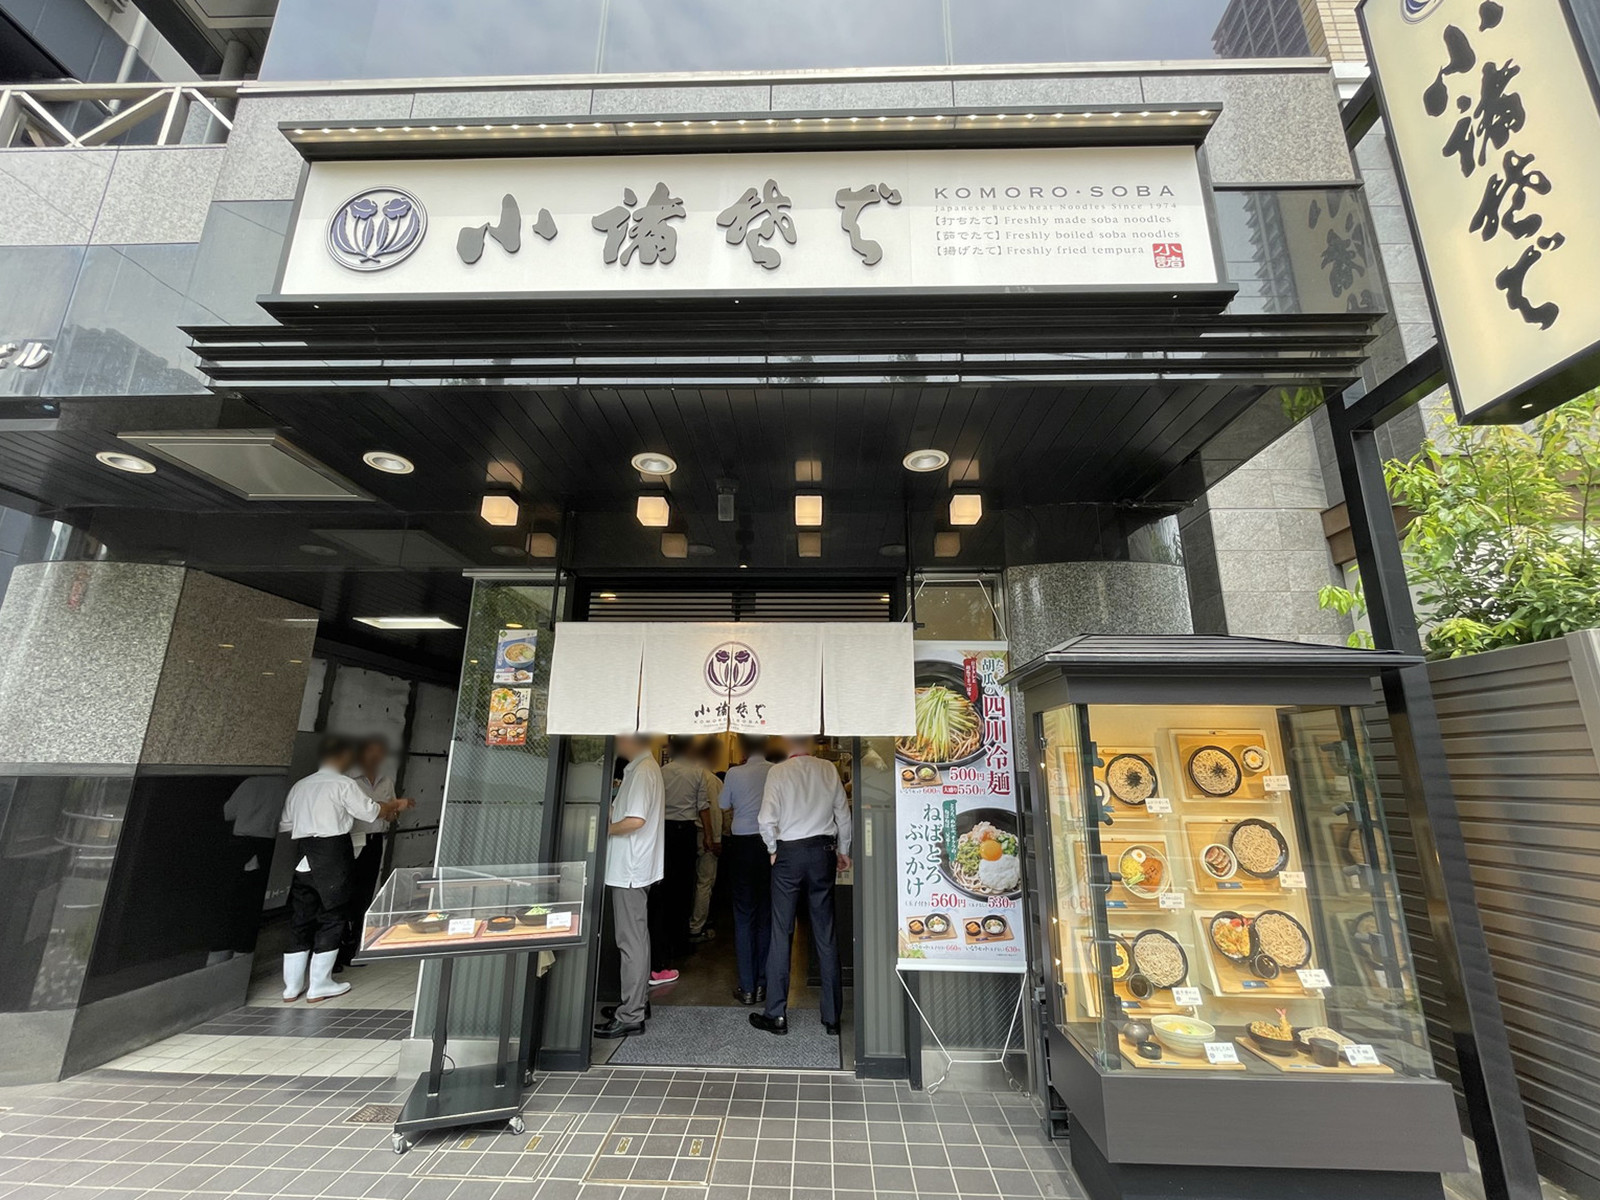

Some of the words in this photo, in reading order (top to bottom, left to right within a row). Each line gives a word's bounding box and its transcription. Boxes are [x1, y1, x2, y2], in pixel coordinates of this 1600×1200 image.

[934, 204, 987, 213] Japanese
[992, 203, 1054, 212] Buckwheat
[1060, 202, 1106, 211] Noodles
[1111, 202, 1143, 210] Since
[1149, 201, 1177, 210] 1974
[1004, 215, 1049, 226] Freshly
[1054, 215, 1087, 225] made
[1091, 214, 1119, 225] soba
[1123, 214, 1172, 224] noodles
[1005, 230, 1051, 241] Freshly
[1055, 230, 1097, 240] boiled
[1099, 230, 1128, 240] soba
[1131, 229, 1180, 239] noodles
[1006, 245, 1052, 256] Freshly
[1056, 245, 1087, 256] fried
[1091, 245, 1145, 256] tempura
[923, 803, 942, 884] ねばとろ
[905, 823, 924, 898] ぶっかけ
[930, 893, 966, 908] 560円
